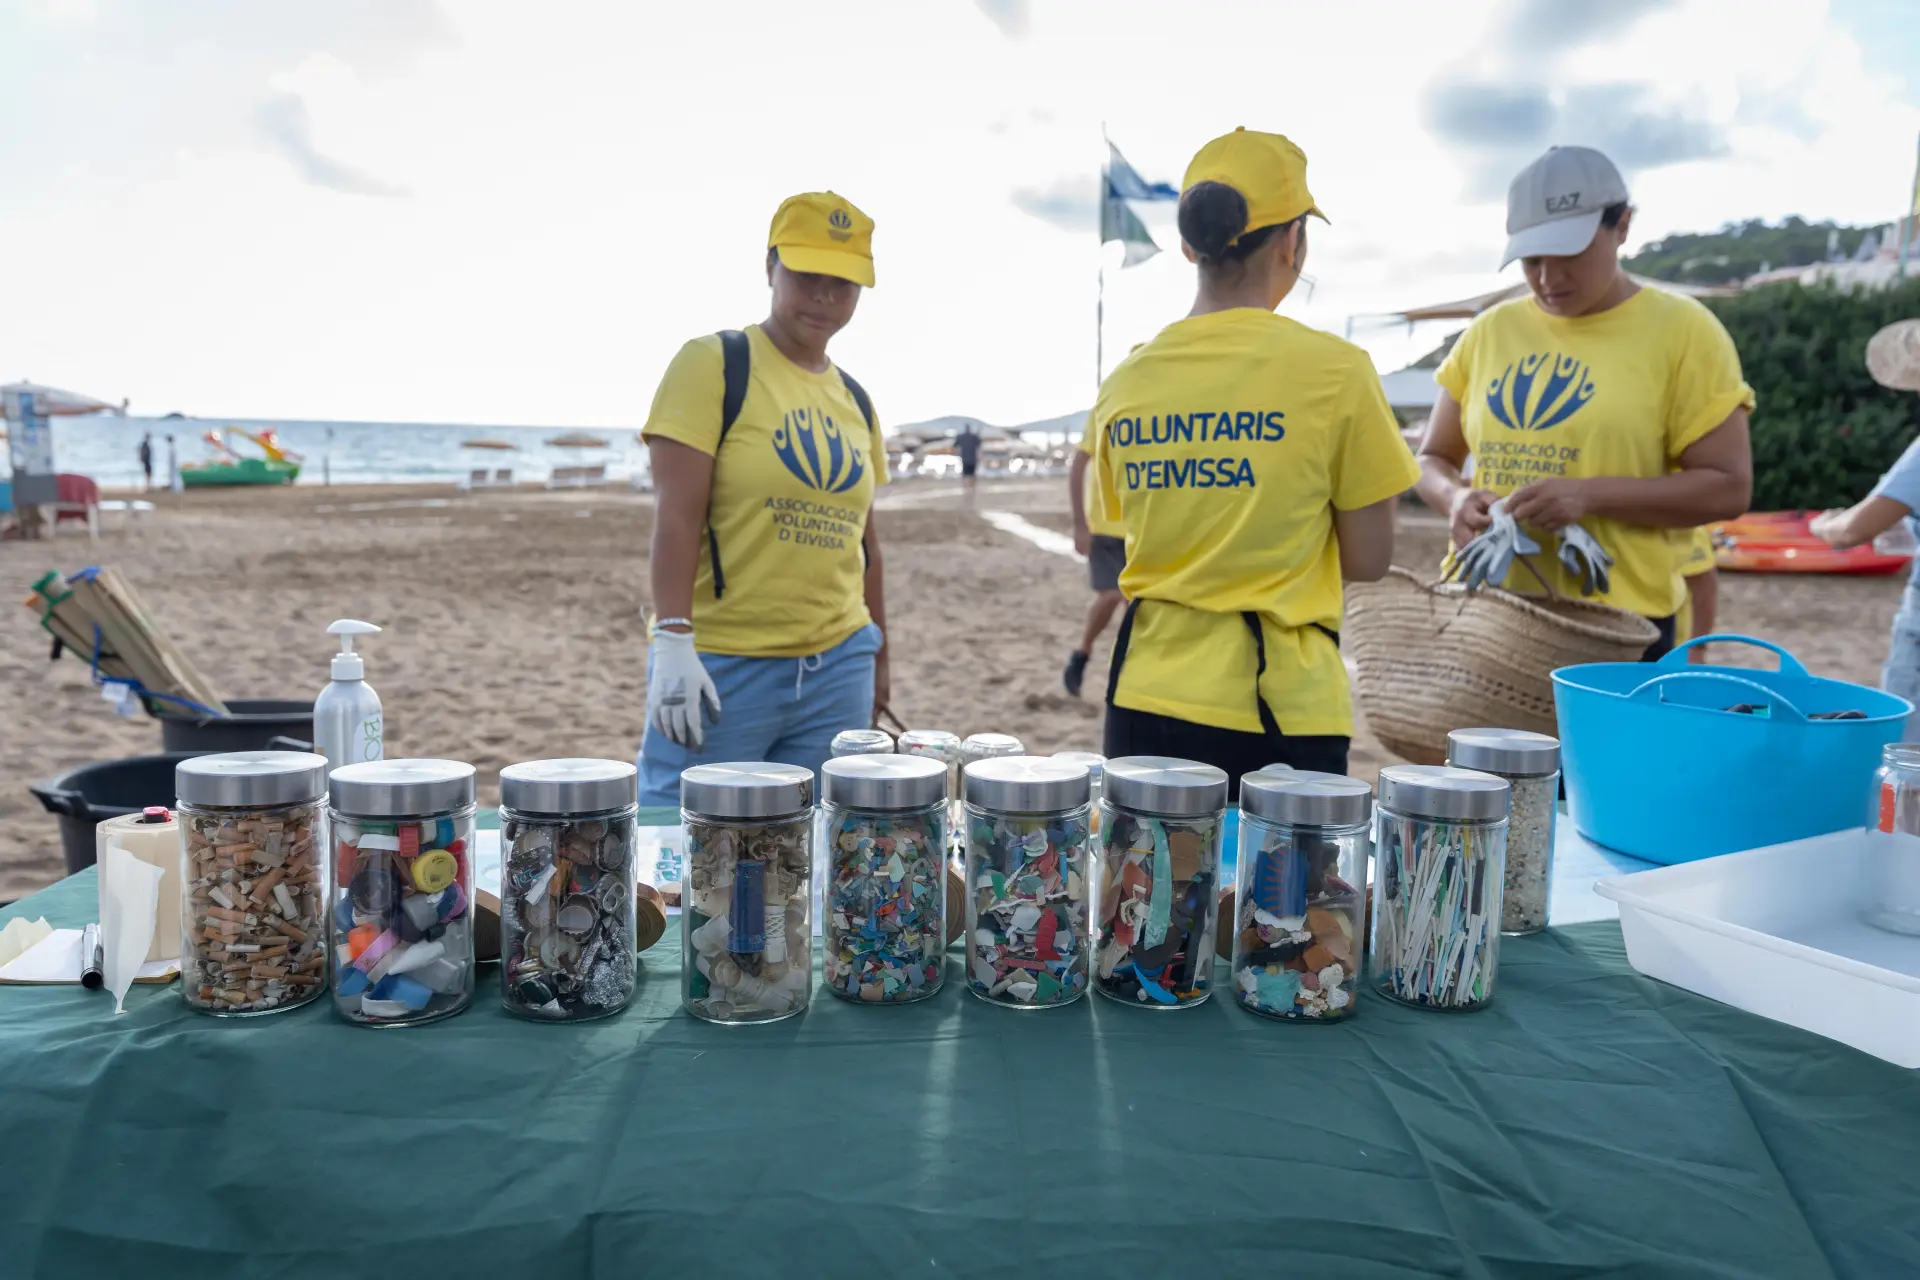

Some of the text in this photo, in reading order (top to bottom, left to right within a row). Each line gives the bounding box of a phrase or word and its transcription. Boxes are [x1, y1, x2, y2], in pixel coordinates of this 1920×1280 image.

[1545, 191, 1580, 214] EA7
[1107, 411, 1286, 449] VOLUNTARIS
[1479, 441, 1580, 462] SSOCIACIÓ DE
[1125, 457, 1256, 490] D'EIVISSA
[1495, 472, 1539, 487] EIVISS
[764, 496, 847, 520] ASSOCIACIÓ
[773, 512, 854, 537] VOLUNTARIS
